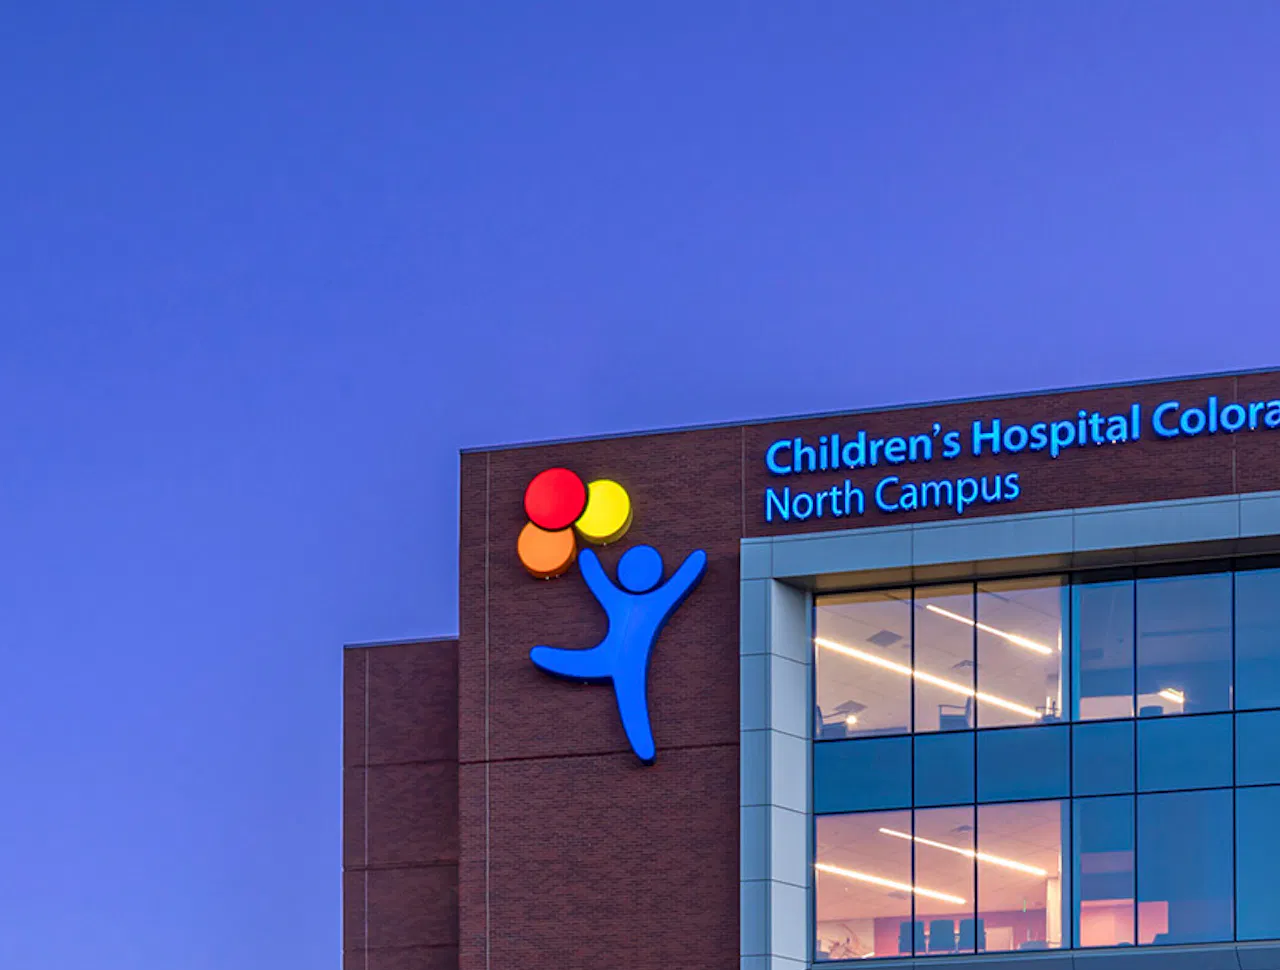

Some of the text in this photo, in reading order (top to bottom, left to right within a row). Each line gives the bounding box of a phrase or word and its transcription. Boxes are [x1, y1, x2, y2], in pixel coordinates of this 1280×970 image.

[765, 423, 960, 475] Children's
[972, 403, 1141, 458] Hospital
[765, 472, 1020, 522] North Campus
